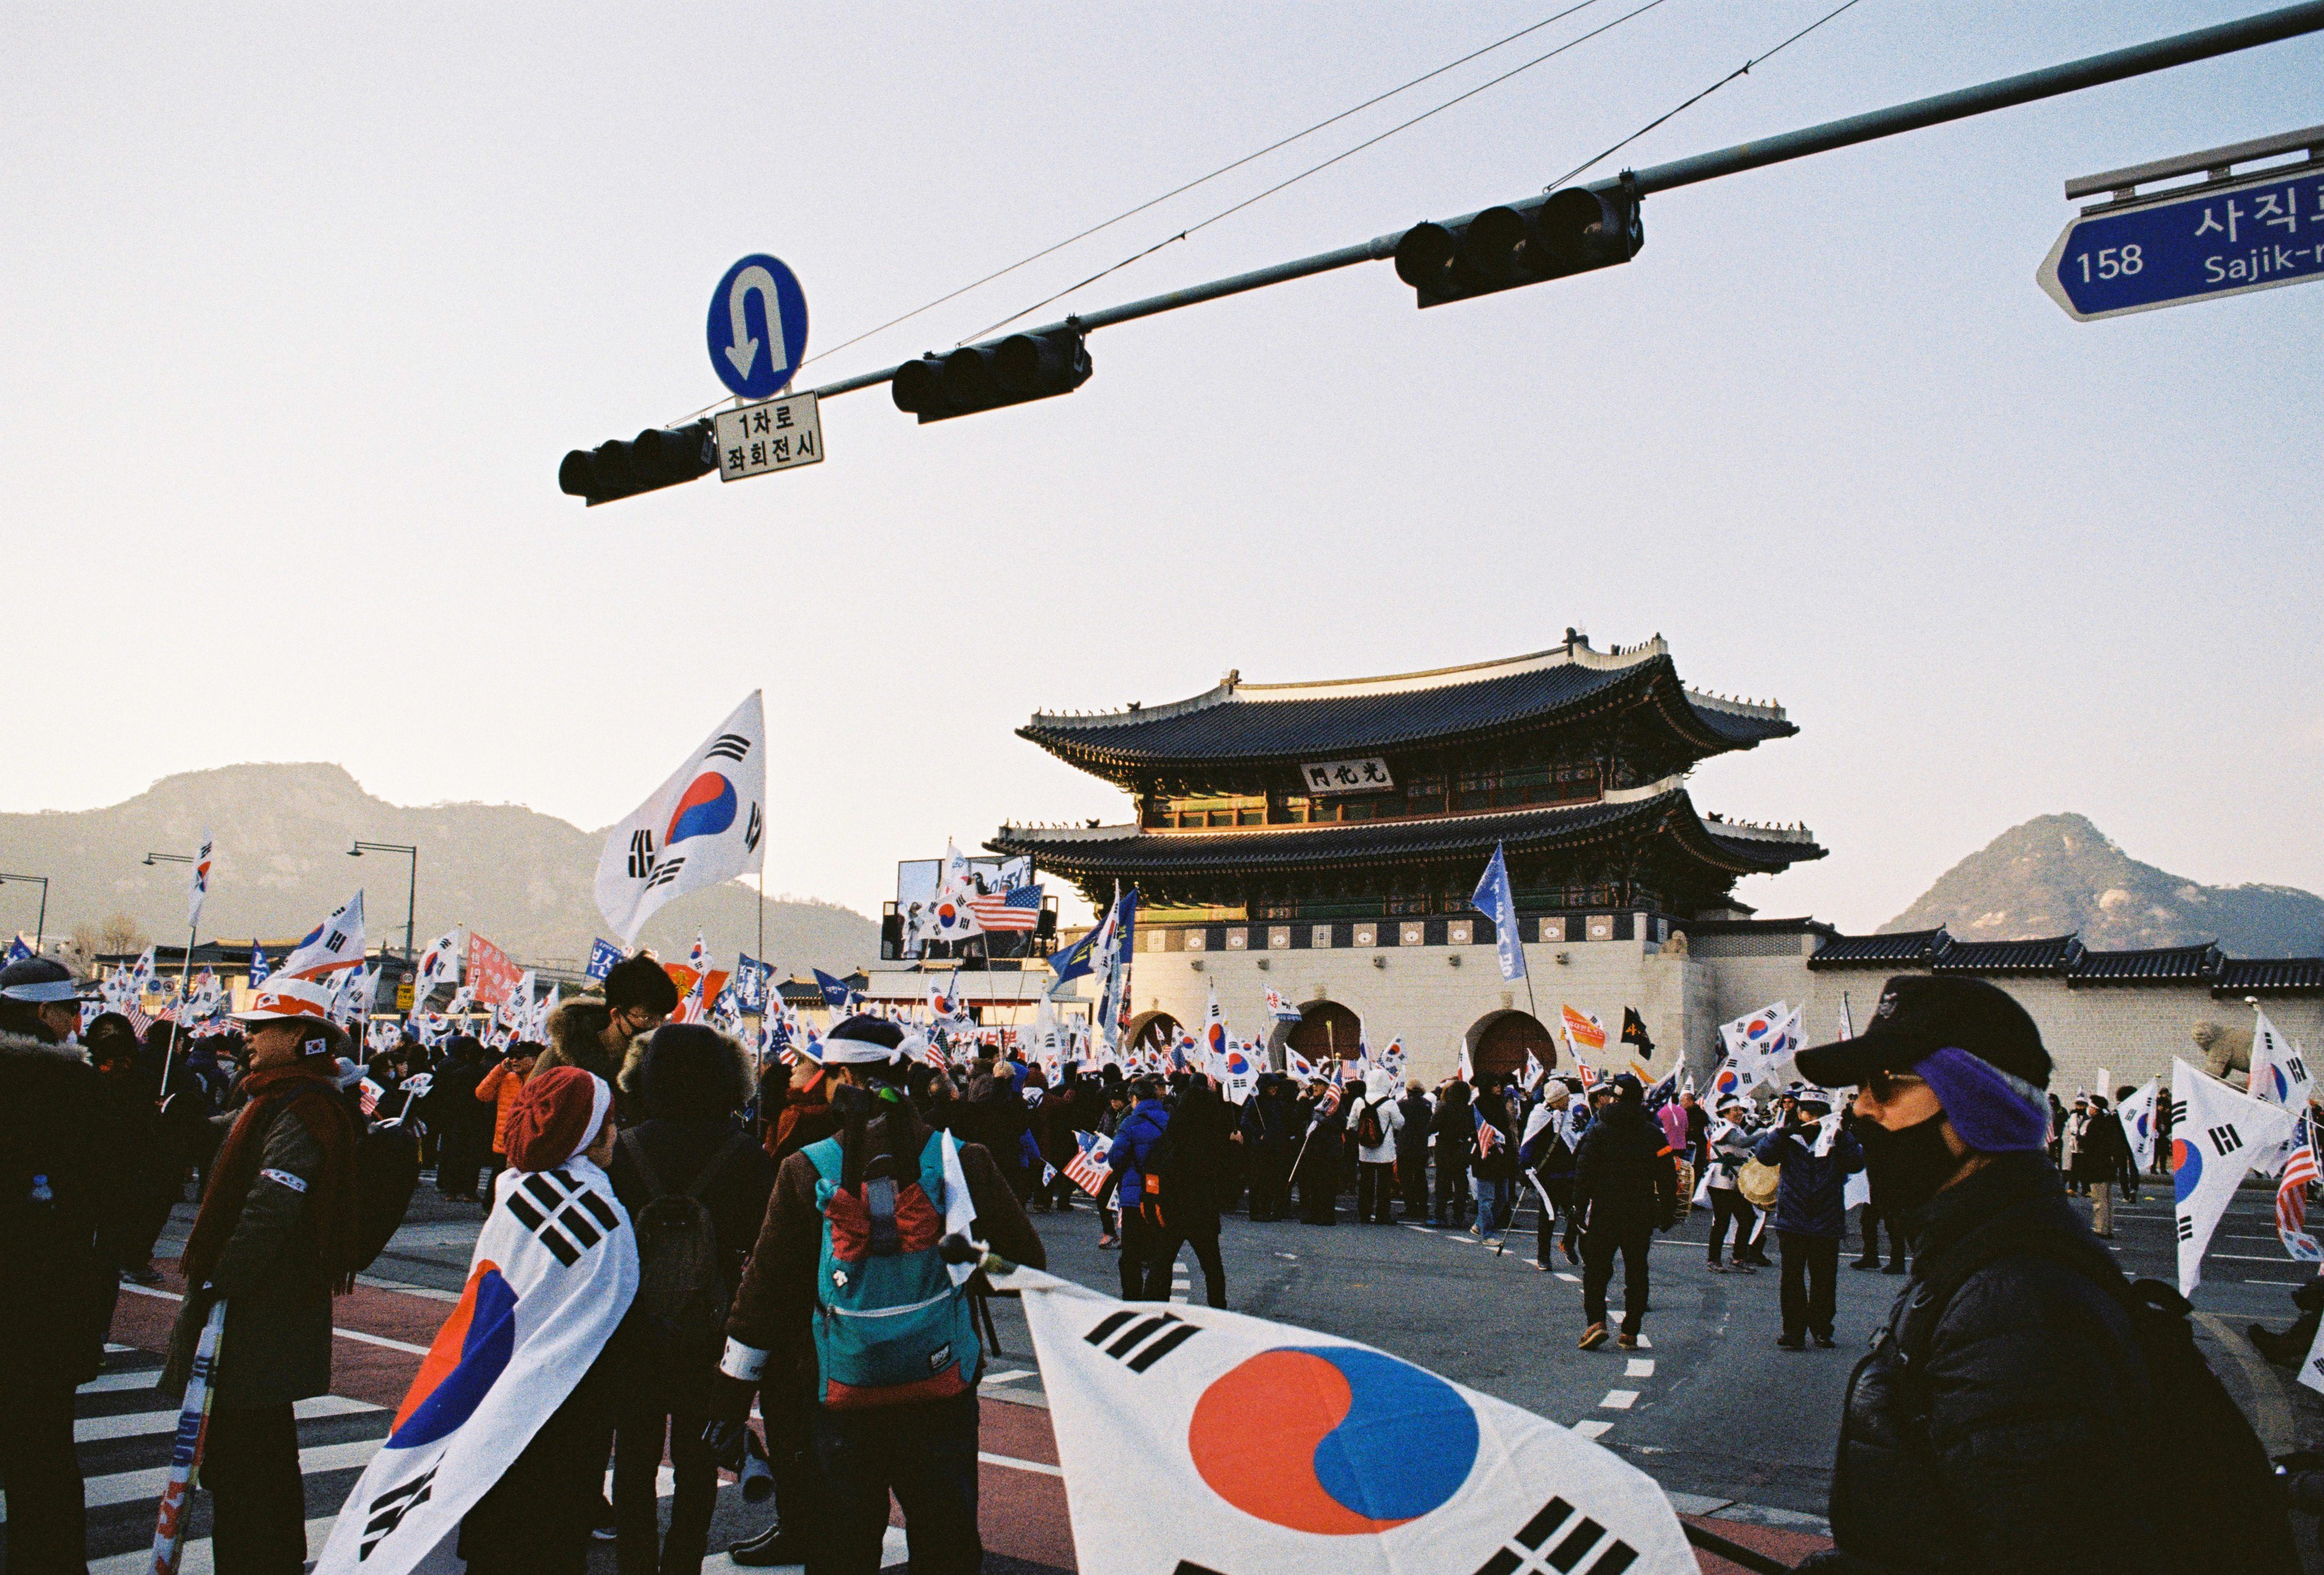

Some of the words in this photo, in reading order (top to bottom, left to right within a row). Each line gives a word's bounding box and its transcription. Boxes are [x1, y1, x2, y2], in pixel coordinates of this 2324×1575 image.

[2077, 243, 2144, 284] 158
[739, 405, 794, 439] 1차로
[728, 429, 815, 471] 좌회전시
